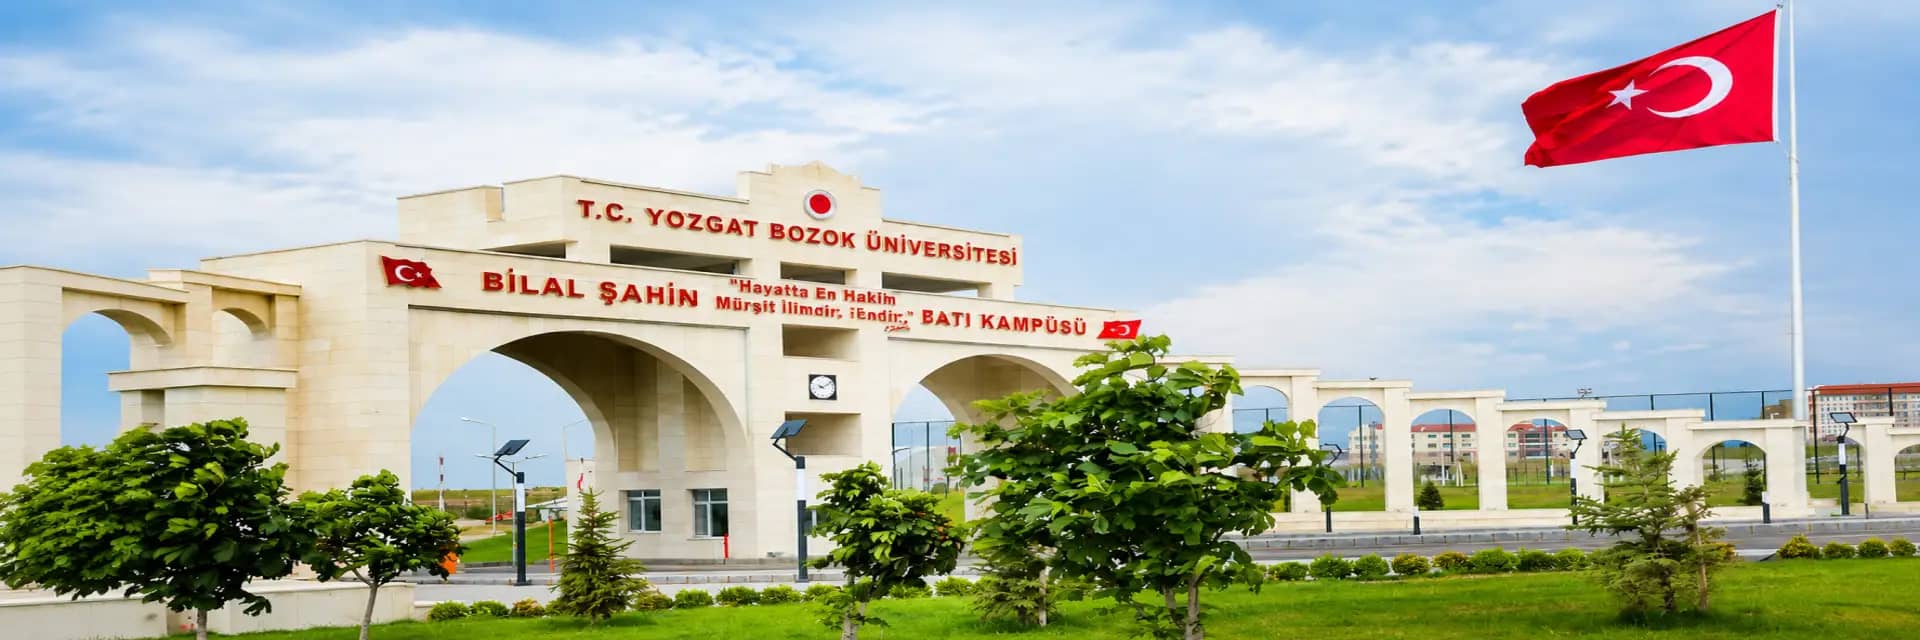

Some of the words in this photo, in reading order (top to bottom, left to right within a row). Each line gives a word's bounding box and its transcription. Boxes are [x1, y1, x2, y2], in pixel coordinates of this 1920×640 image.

[576, 199, 633, 224] T.C.
[646, 208, 758, 237] YOZGAT
[769, 222, 855, 249] BOZOK
[866, 230, 1017, 265] ÜNİVERSİTESİ
[482, 268, 584, 299] BİLAL
[598, 281, 698, 310] ŞAHİN
[815, 287, 837, 301] En
[715, 295, 776, 315] Mürşit
[921, 308, 972, 327] BATI
[980, 314, 1087, 336] KAMPÜSÜ
